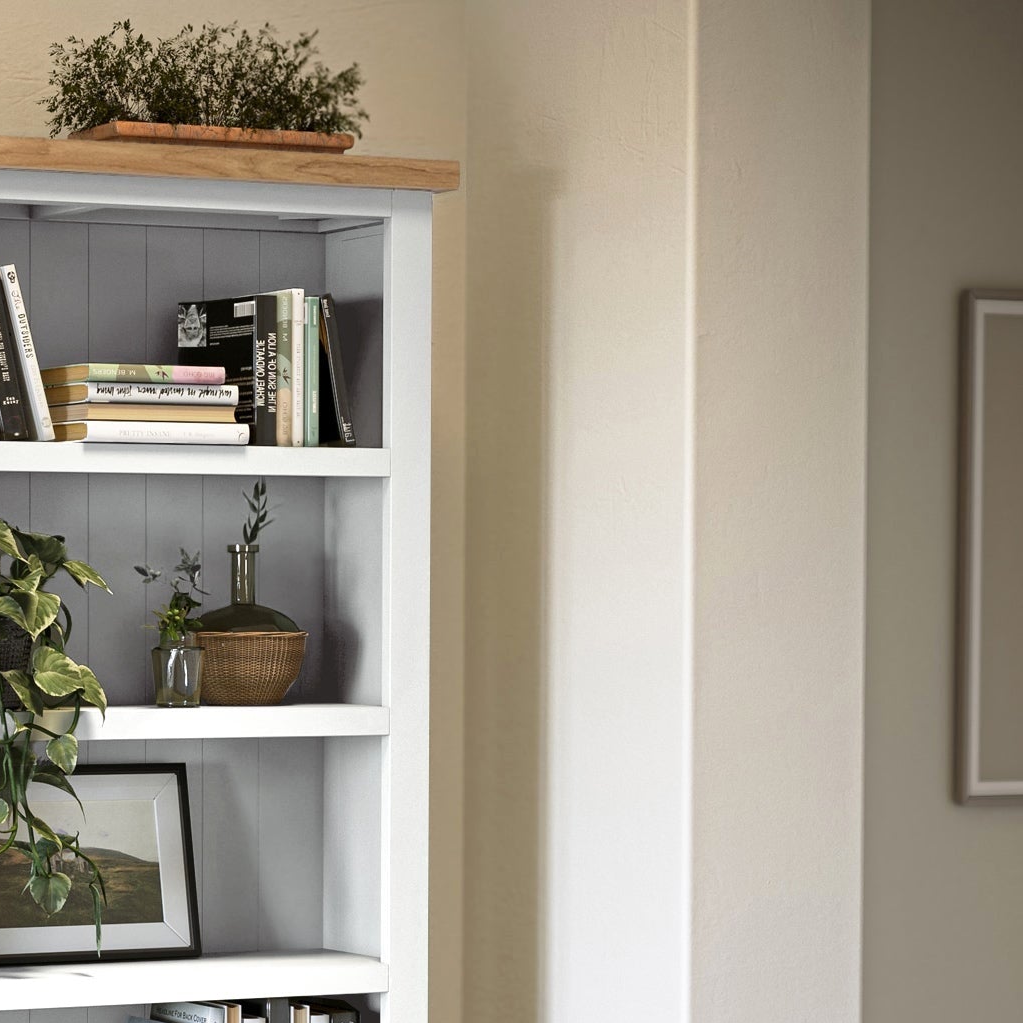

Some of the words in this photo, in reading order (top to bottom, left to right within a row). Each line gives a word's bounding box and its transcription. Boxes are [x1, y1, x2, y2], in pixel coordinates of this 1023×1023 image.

[17, 313, 34, 359] OUTSIDERS
[183, 1011, 193, 1021] BACK
[194, 1014, 207, 1023] COVER
